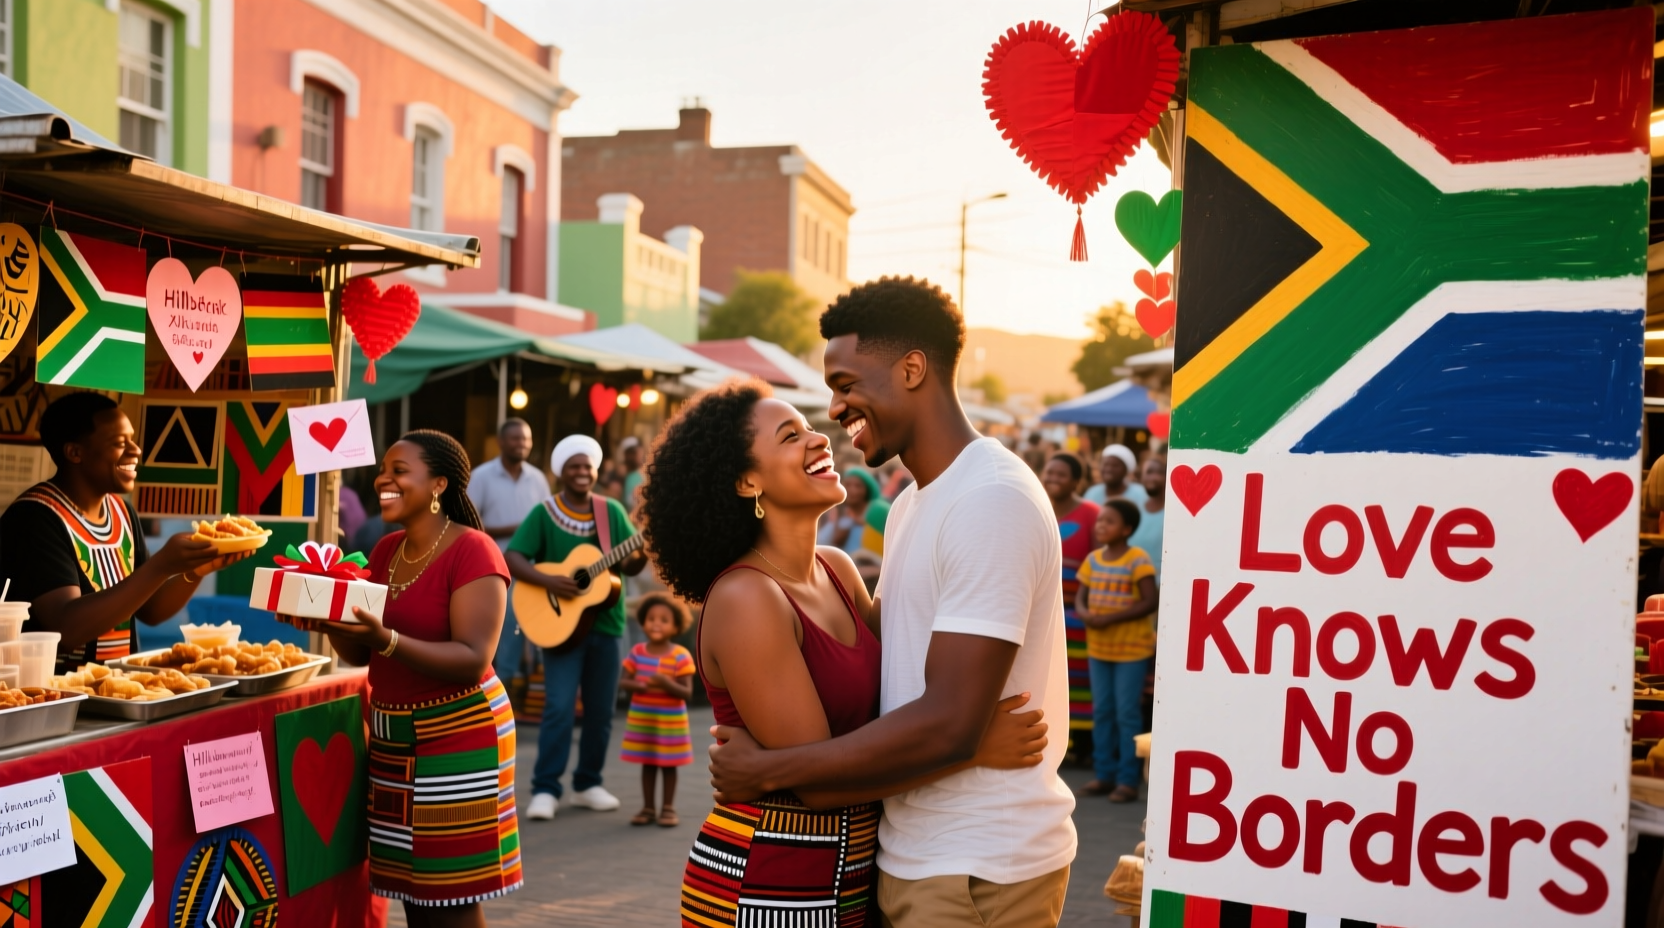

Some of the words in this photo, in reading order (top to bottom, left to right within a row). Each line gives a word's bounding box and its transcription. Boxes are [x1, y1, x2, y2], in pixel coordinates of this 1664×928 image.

[1240, 473, 1496, 583] Love
[1186, 579, 1537, 700] Knows
[1281, 687, 1414, 776] No
[1168, 750, 1609, 916] Borders
